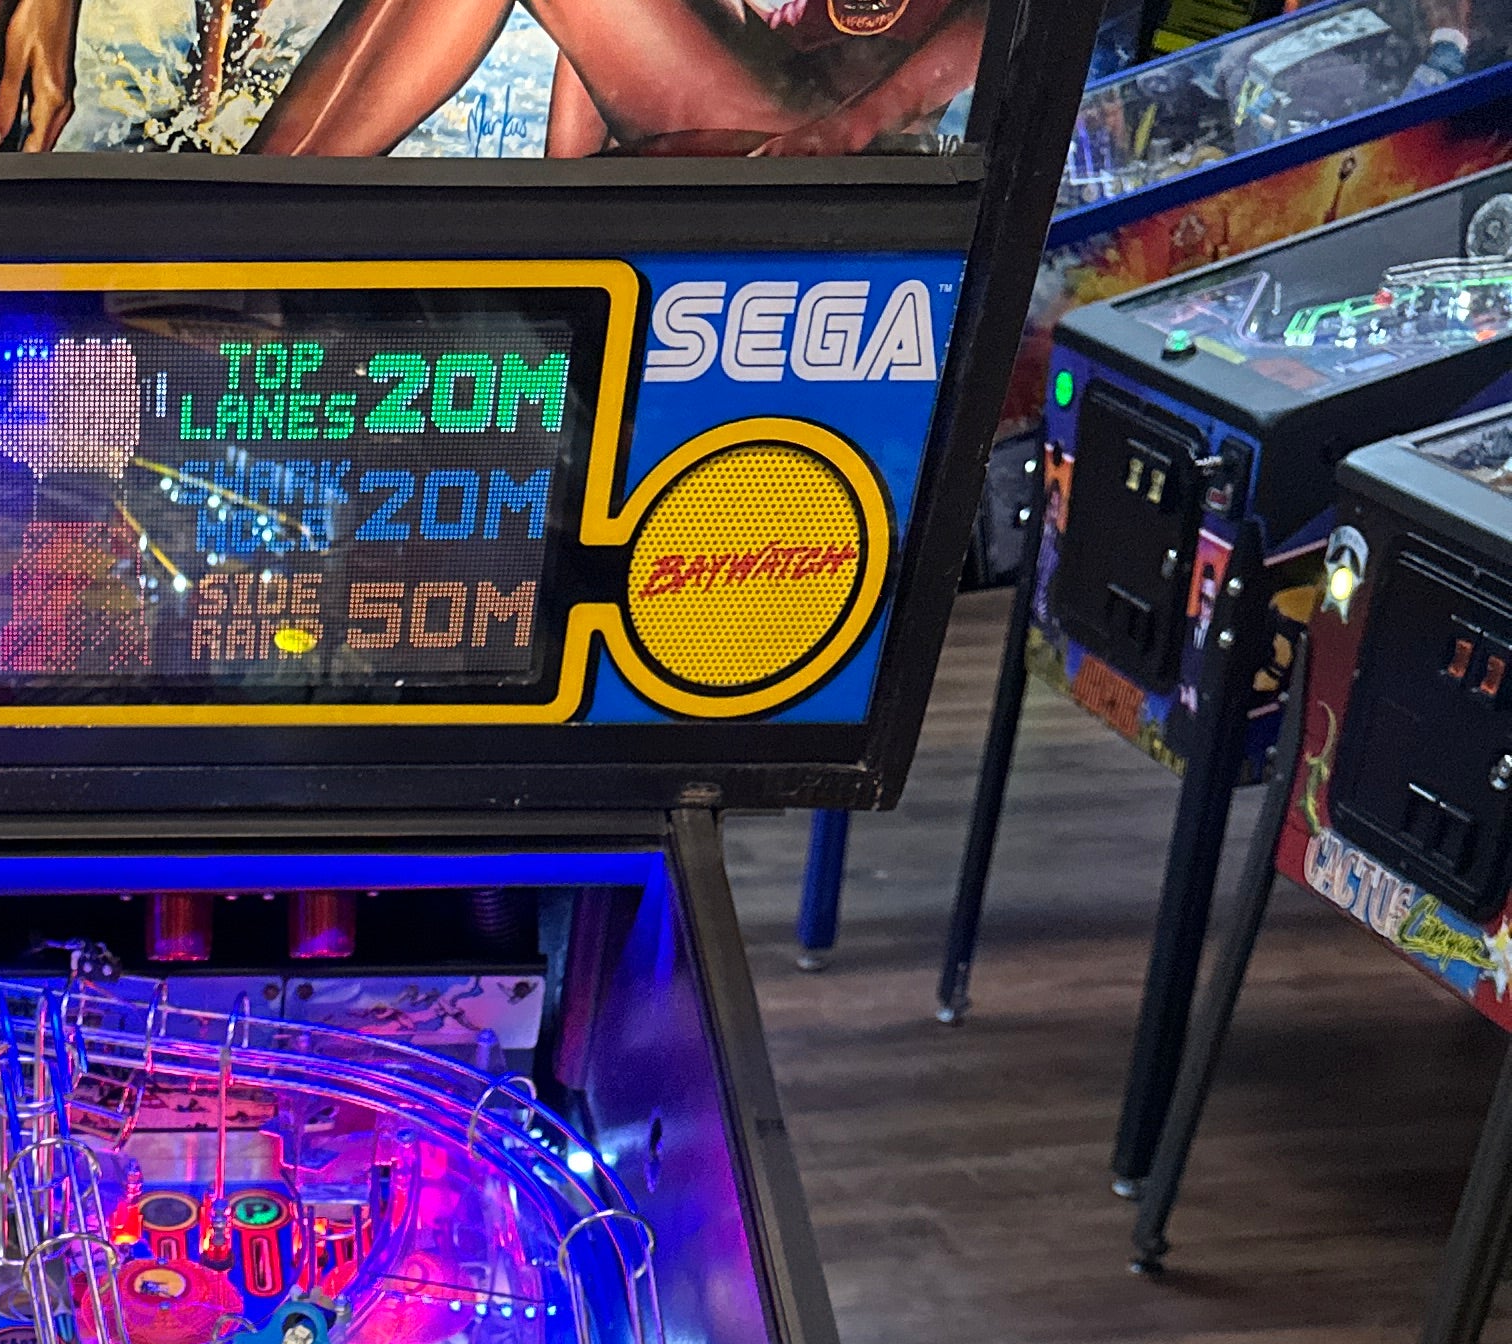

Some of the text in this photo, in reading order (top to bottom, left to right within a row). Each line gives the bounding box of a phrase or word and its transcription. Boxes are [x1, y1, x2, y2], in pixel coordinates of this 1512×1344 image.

[219, 342, 325, 391] TOP
[644, 279, 938, 382] SEGA
[179, 352, 570, 440] LANES 20M
[179, 458, 551, 541] SHARK 20M
[638, 541, 858, 601] BAYWATCH
[192, 618, 324, 660] RAMP
[199, 573, 537, 649] SIDE 50M
[1304, 828, 1415, 942] CACTUS
